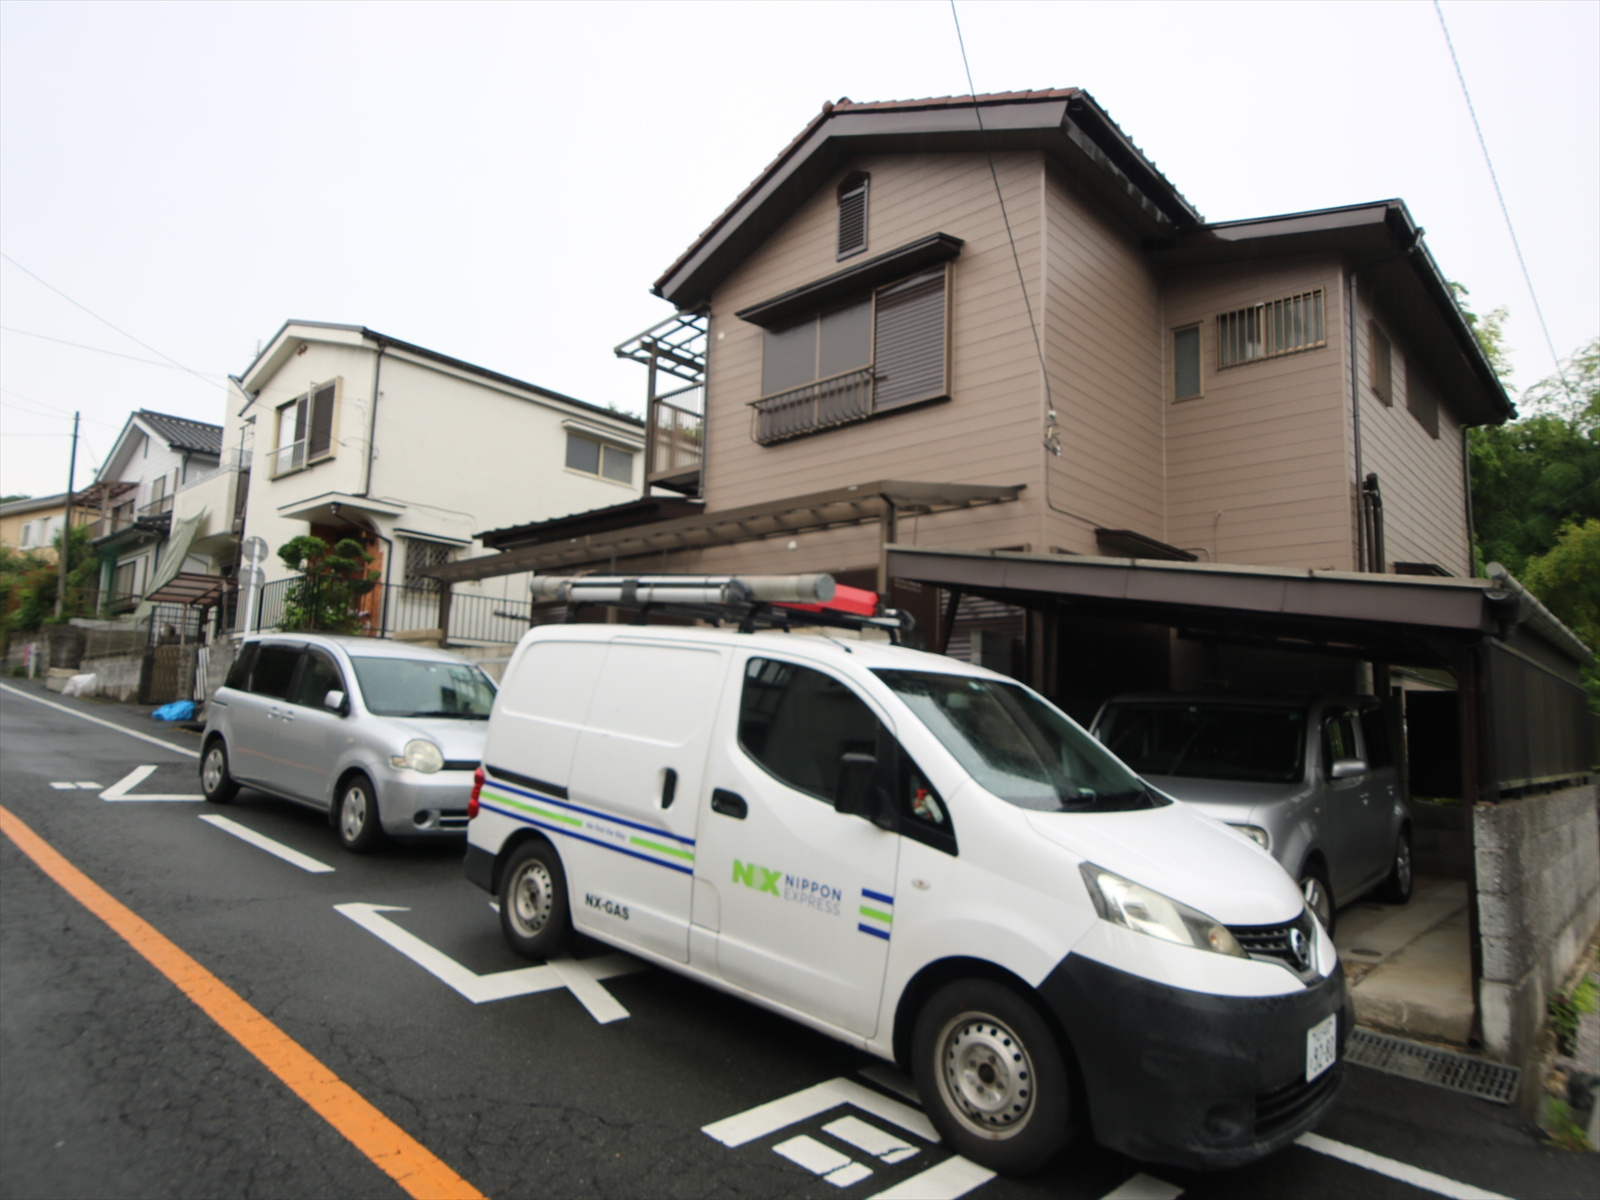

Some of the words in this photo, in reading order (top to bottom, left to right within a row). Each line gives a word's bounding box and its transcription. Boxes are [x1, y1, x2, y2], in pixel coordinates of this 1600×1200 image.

[732, 859, 782, 896] NX
[785, 874, 842, 902] NIPPON
[585, 892, 629, 920] NX-GAS
[784, 887, 841, 916] EXPRESS
